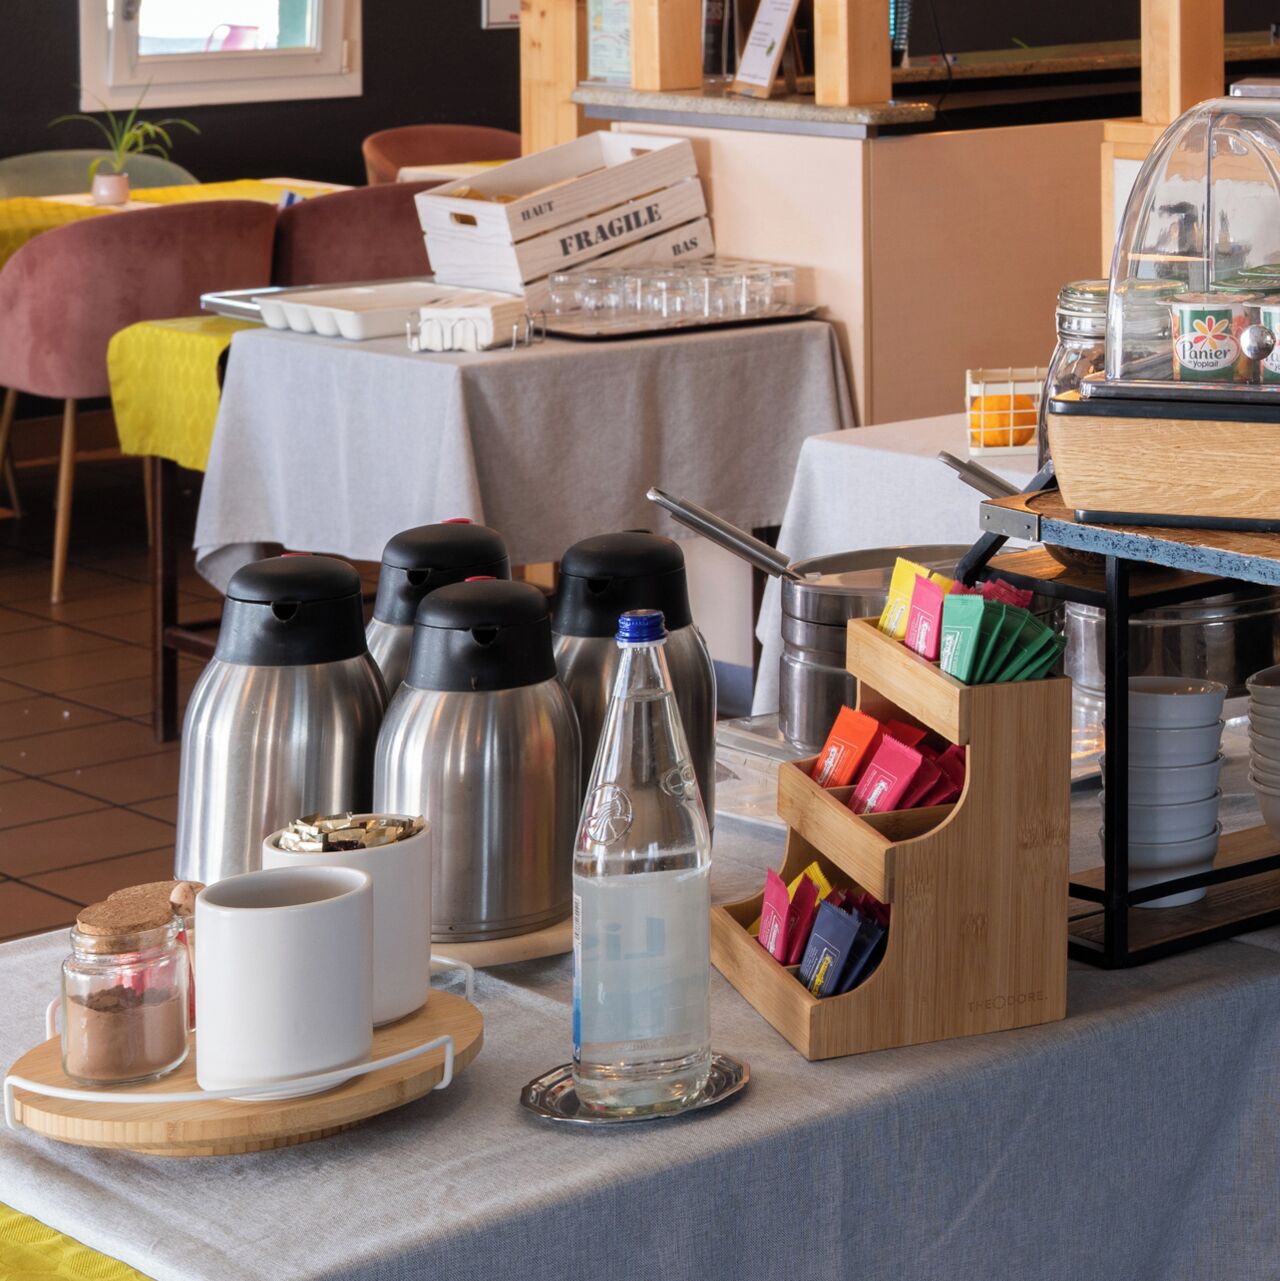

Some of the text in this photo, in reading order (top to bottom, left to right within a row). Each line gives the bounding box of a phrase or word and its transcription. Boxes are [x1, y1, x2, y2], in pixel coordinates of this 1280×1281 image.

[520, 200, 555, 222] HAUT
[559, 203, 662, 257] FRAGILE
[672, 237, 699, 257] BAS
[1182, 341, 1231, 361] Panier
